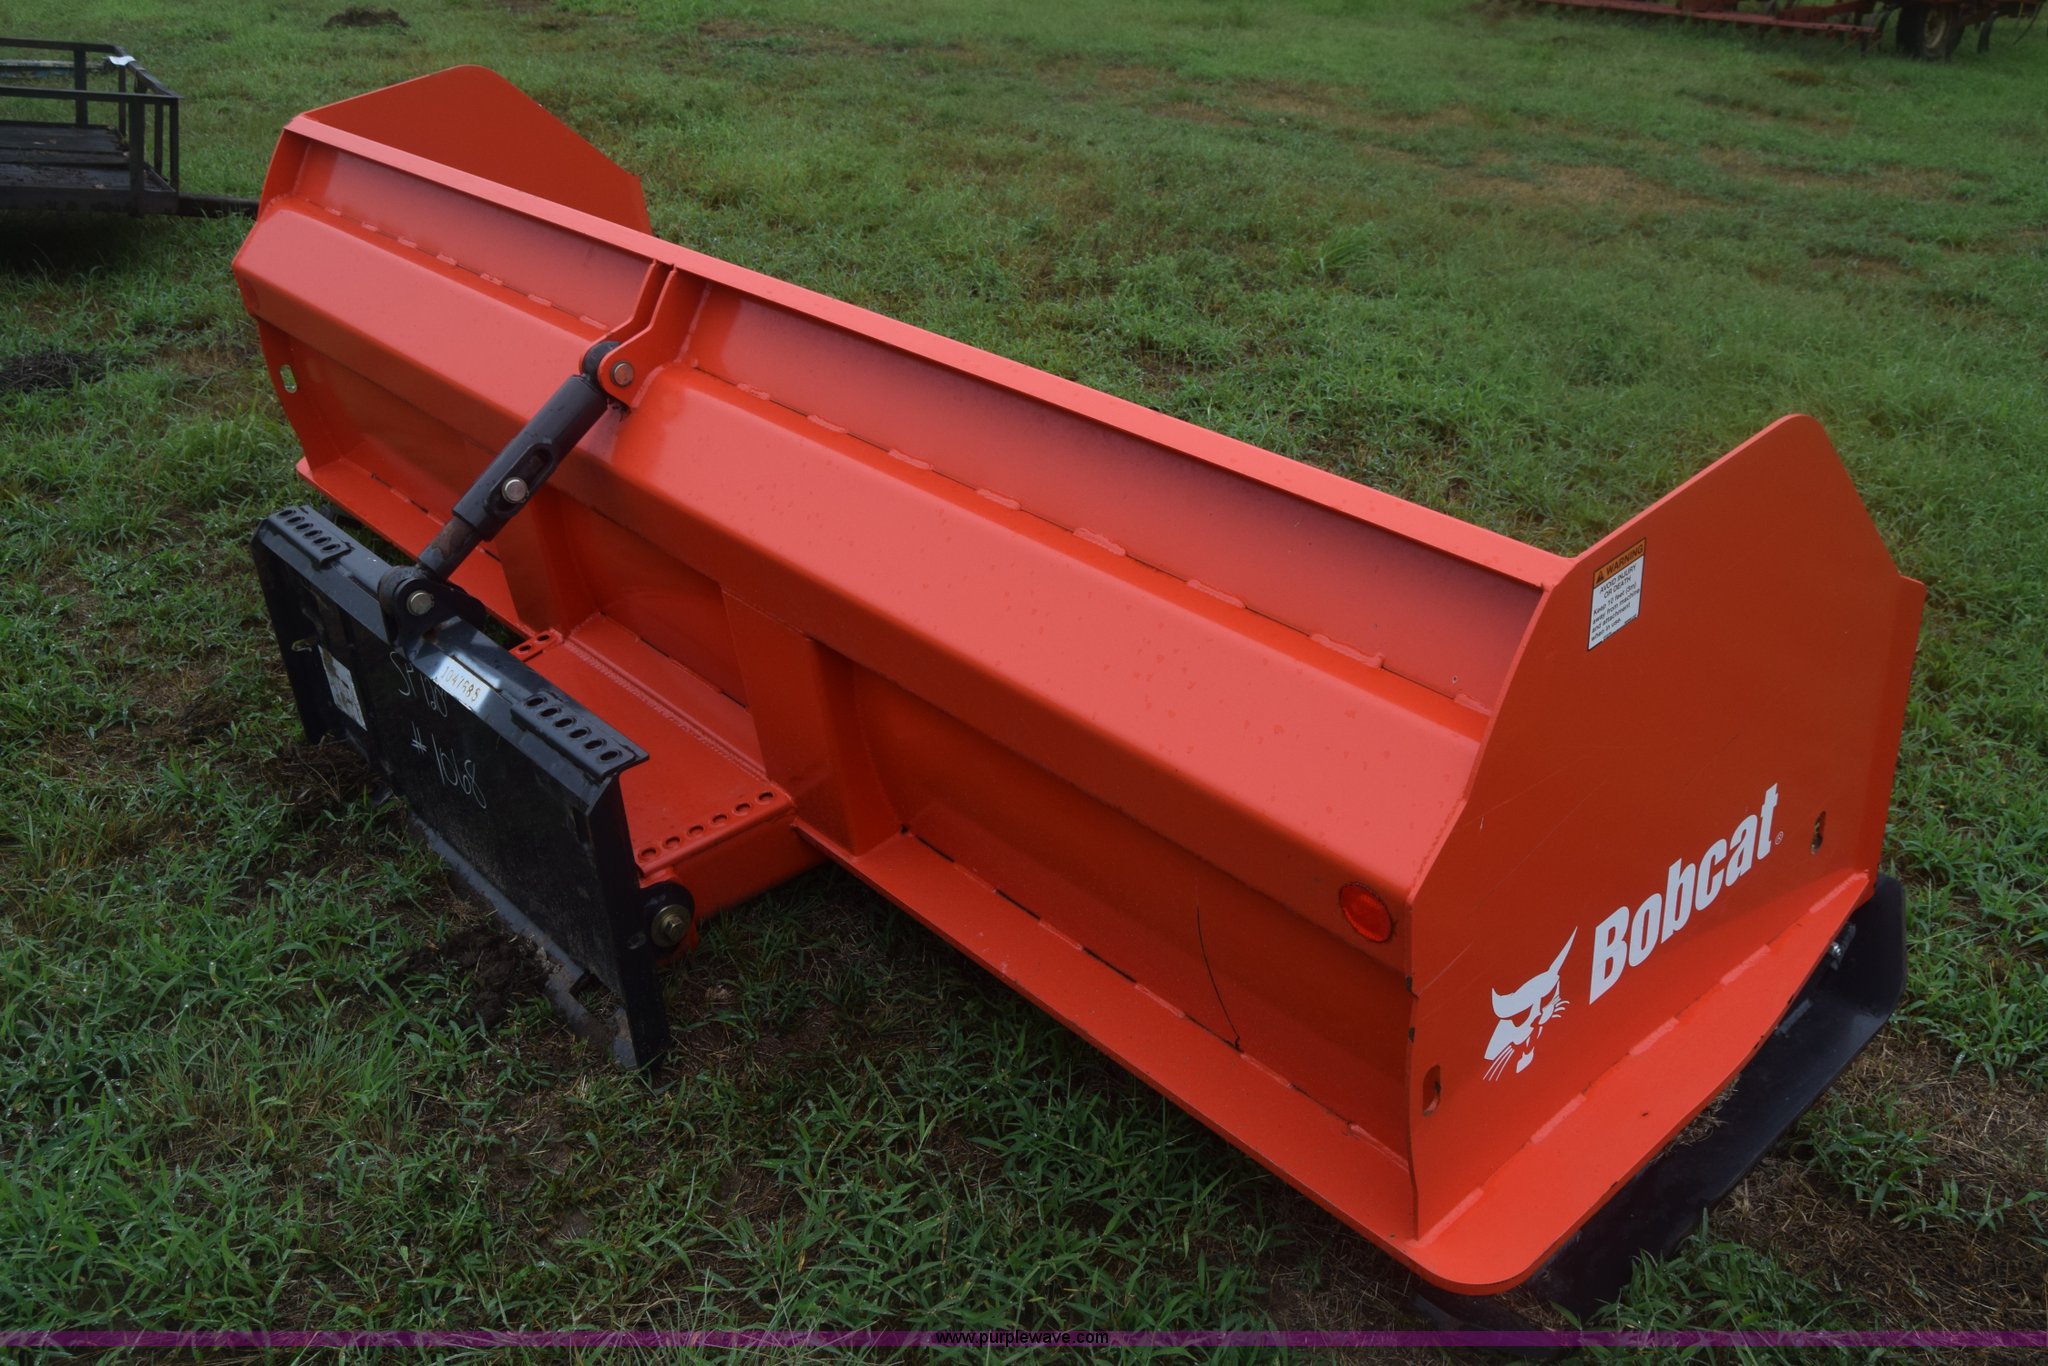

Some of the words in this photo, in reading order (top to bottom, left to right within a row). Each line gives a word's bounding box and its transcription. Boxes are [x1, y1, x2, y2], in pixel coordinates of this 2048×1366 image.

[1606, 544, 1643, 576] WARNING
[1600, 577, 1617, 593] AVOID
[1618, 563, 1637, 582] INJURY
[1613, 576, 1631, 593] DEATH
[1589, 783, 1778, 1005] Bobcat
